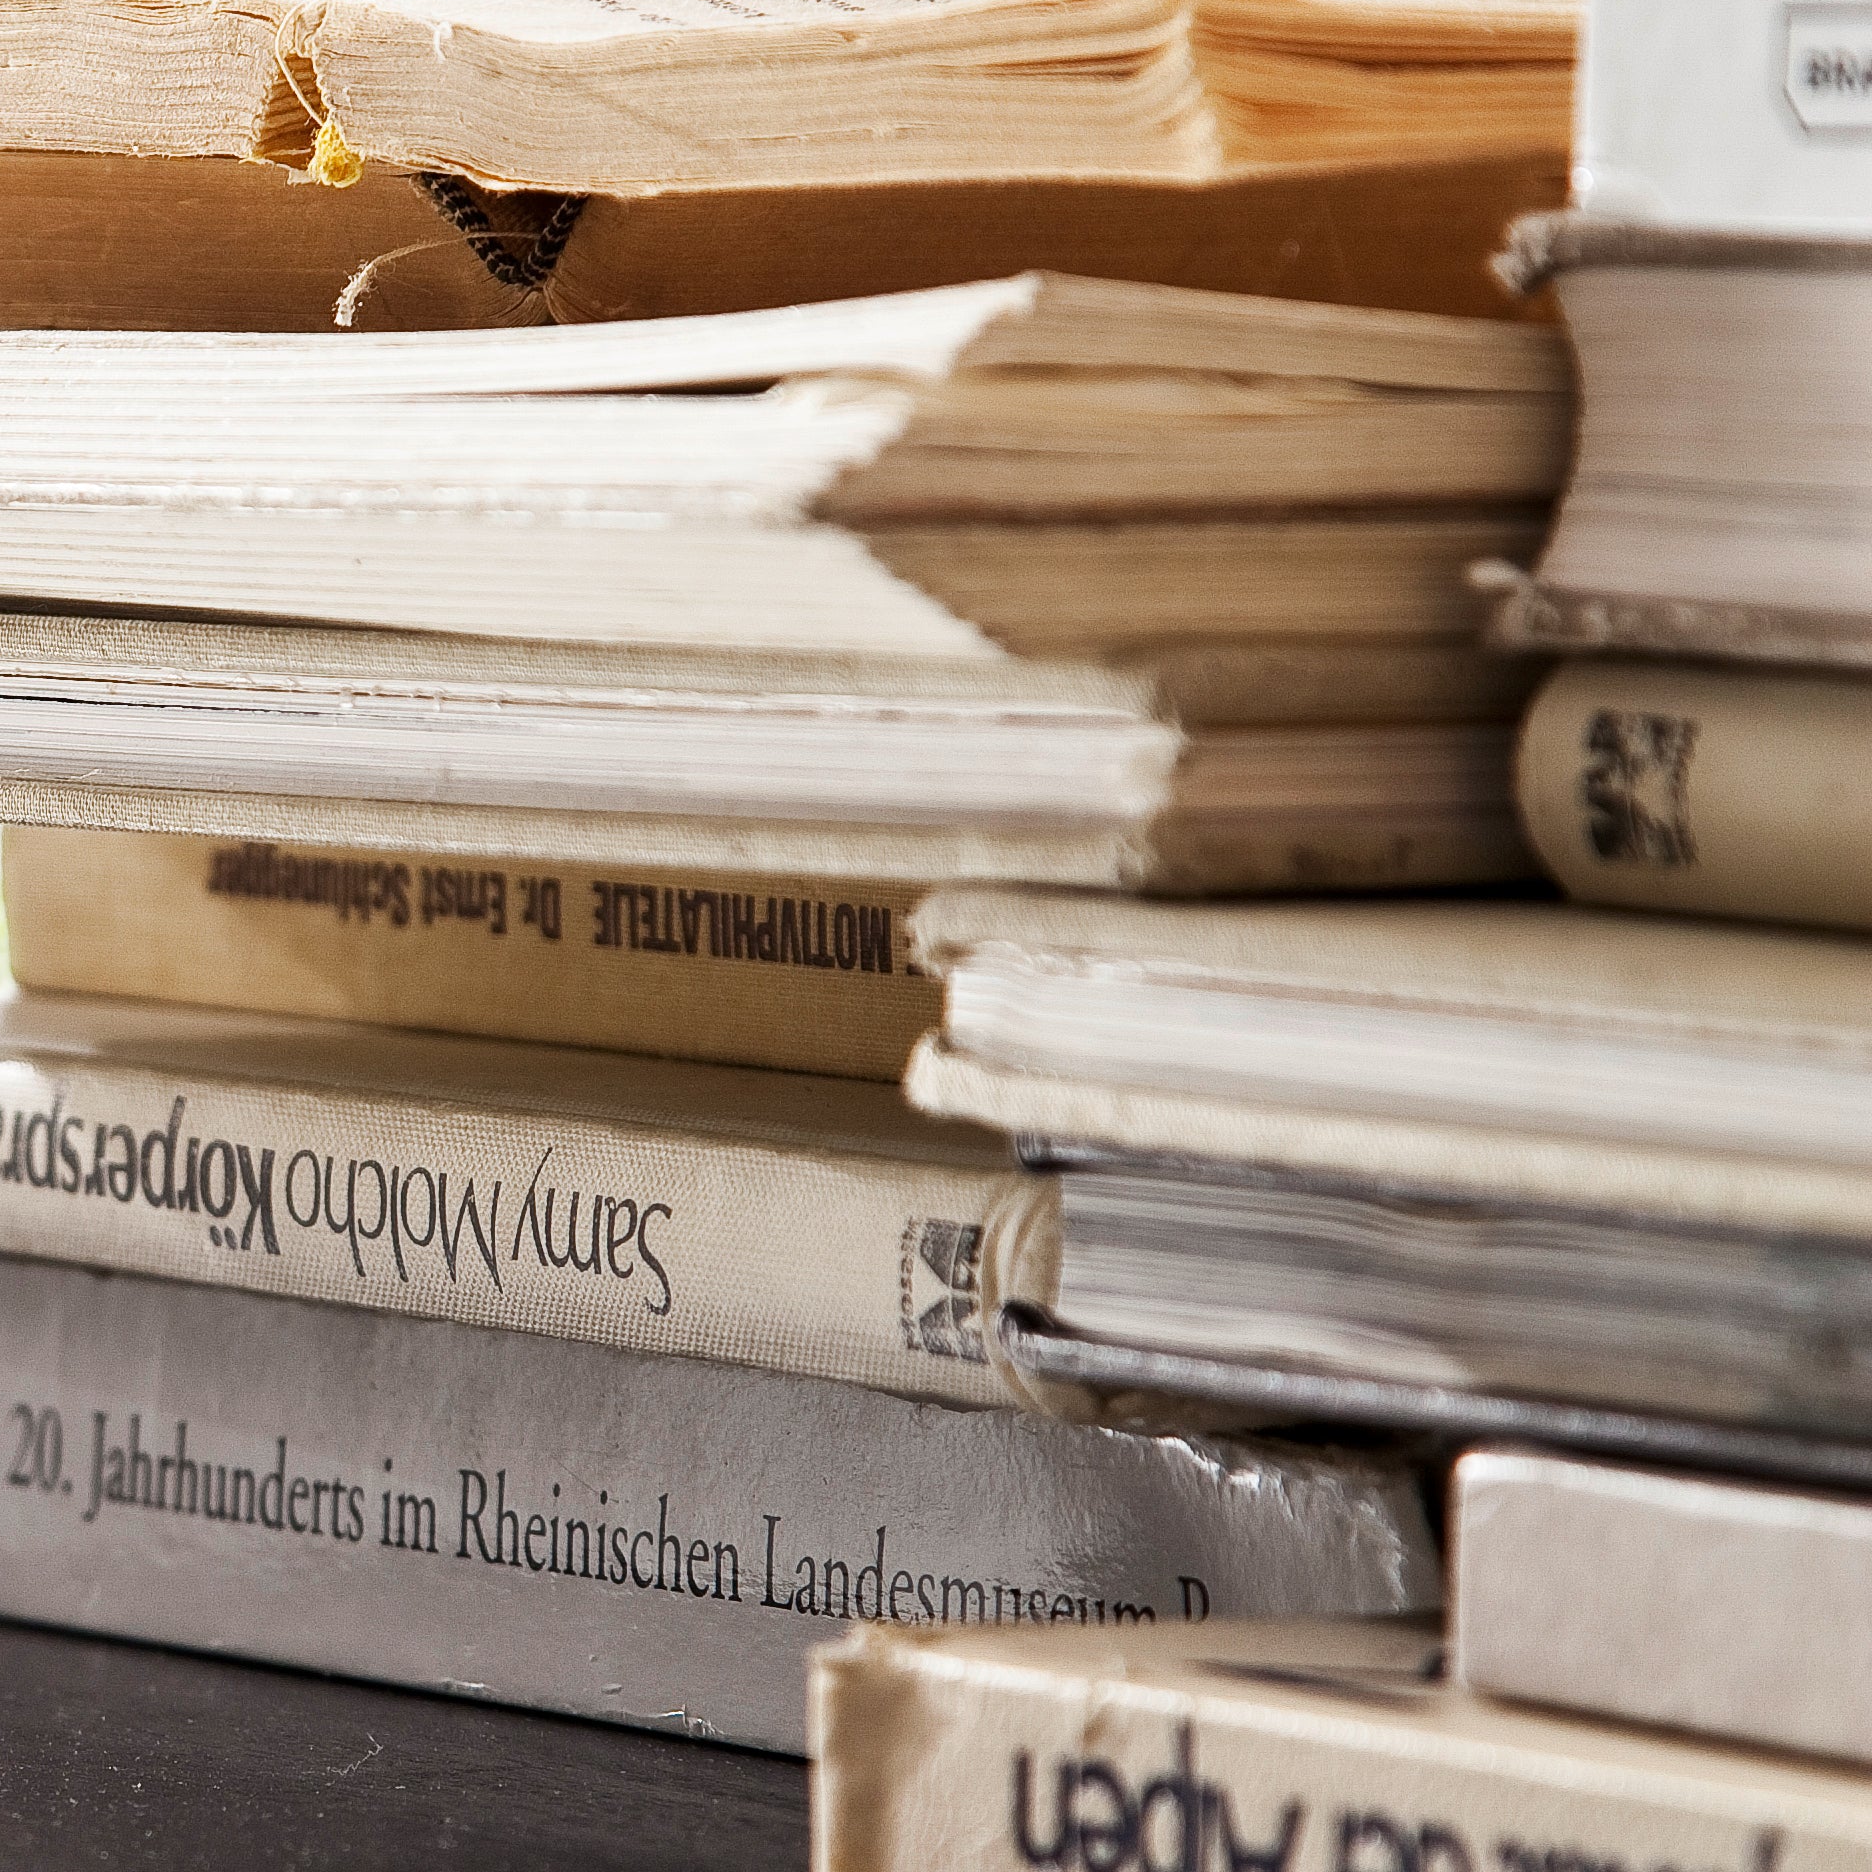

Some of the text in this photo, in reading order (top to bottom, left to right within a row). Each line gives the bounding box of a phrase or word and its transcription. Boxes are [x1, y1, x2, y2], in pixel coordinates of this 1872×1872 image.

[422, 864, 507, 934] Ernst
[519, 875, 562, 941] Dr.
[592, 880, 893, 974] MOTIVPHILATELIE
[285, 1148, 504, 1295] Molcho
[510, 1146, 673, 1317] Samy
[7, 1401, 75, 1496] 20.
[81, 1409, 366, 1543] Jahrhunderts
[378, 1456, 440, 1554] im
[456, 1468, 743, 1603] Rheinischen
